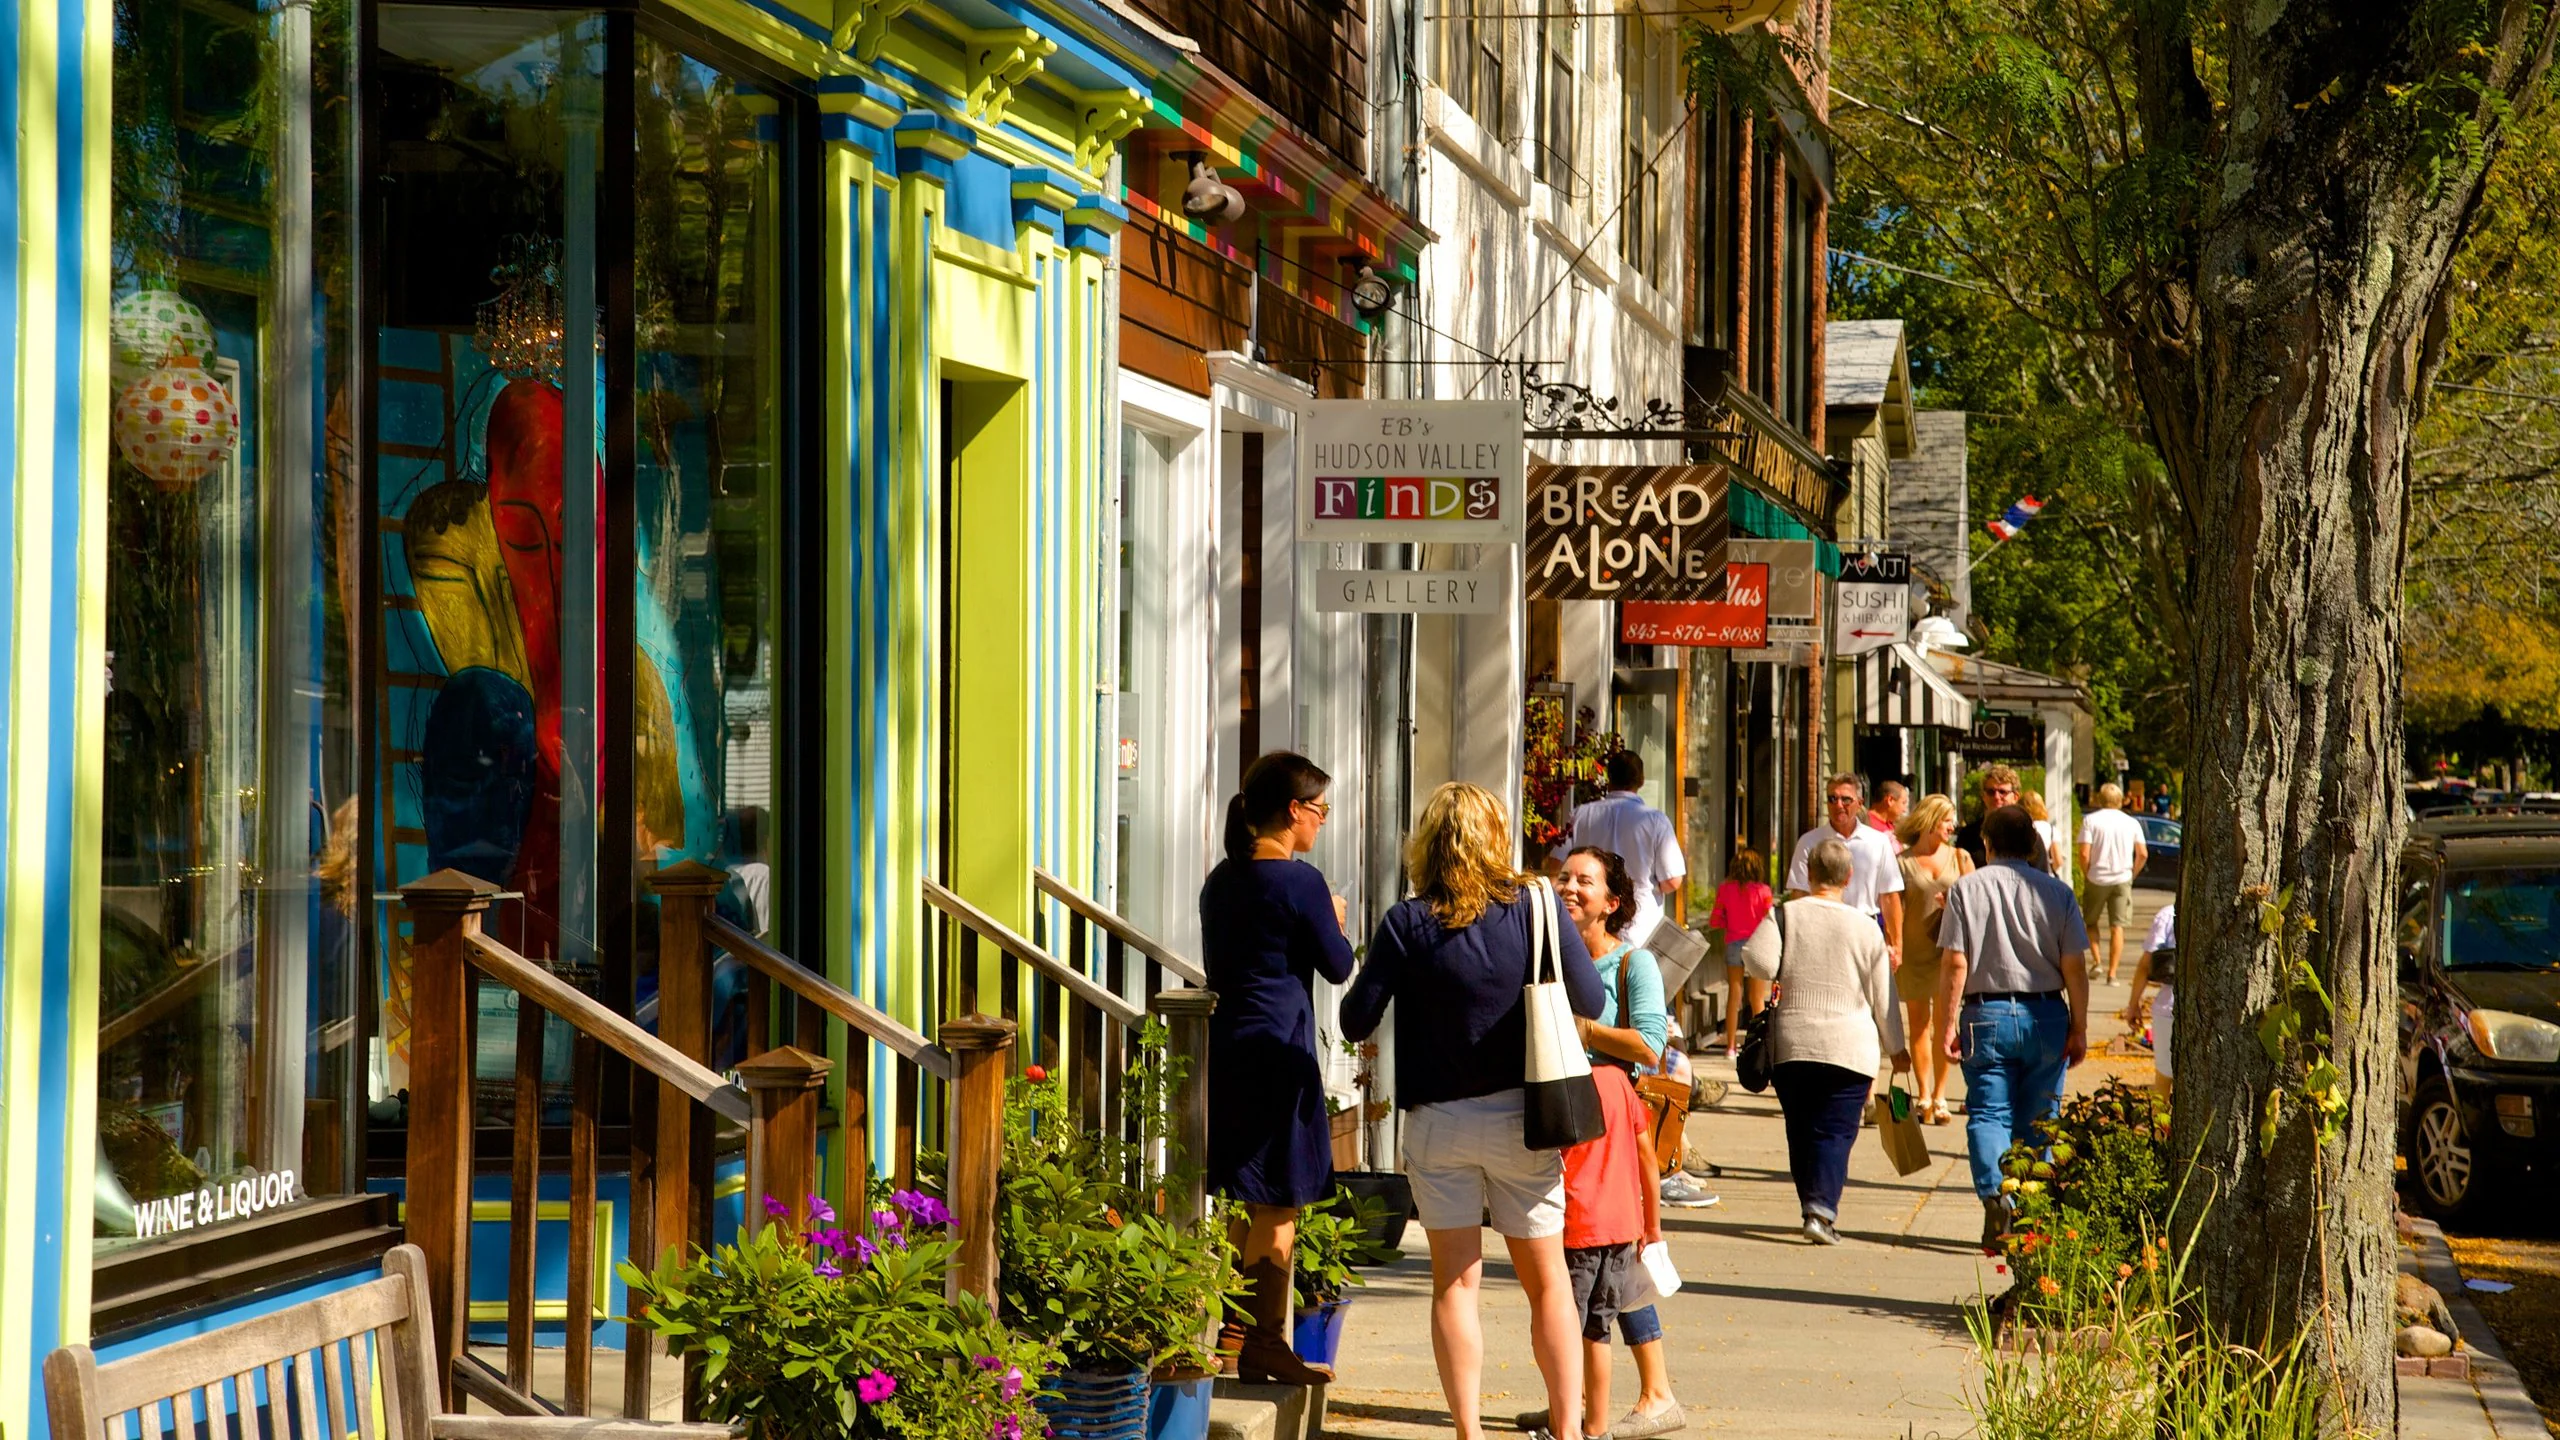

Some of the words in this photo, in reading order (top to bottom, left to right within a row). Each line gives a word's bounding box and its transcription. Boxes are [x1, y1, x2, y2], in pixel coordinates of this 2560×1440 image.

[1381, 416, 1433, 437] EB's
[1315, 443, 1406, 470] HUDSON
[1418, 443, 1500, 470] VALLEY
[1753, 430, 1798, 500] HARDWARE
[1795, 463, 1829, 520] COMPANY
[1543, 475, 1710, 526] BREAD
[1542, 524, 1708, 591] ALONE
[1343, 579, 1479, 604] GALLERY
[1634, 582, 1704, 592] BAKERY
[1842, 591, 1904, 609] SUSHI
[1842, 613, 1851, 623] &
[1853, 611, 1904, 624] HIBACHI
[1963, 717, 2006, 740] roi
[133, 1191, 195, 1240] WINE
[198, 1188, 214, 1226] &
[217, 1169, 295, 1220] LIQUOR
